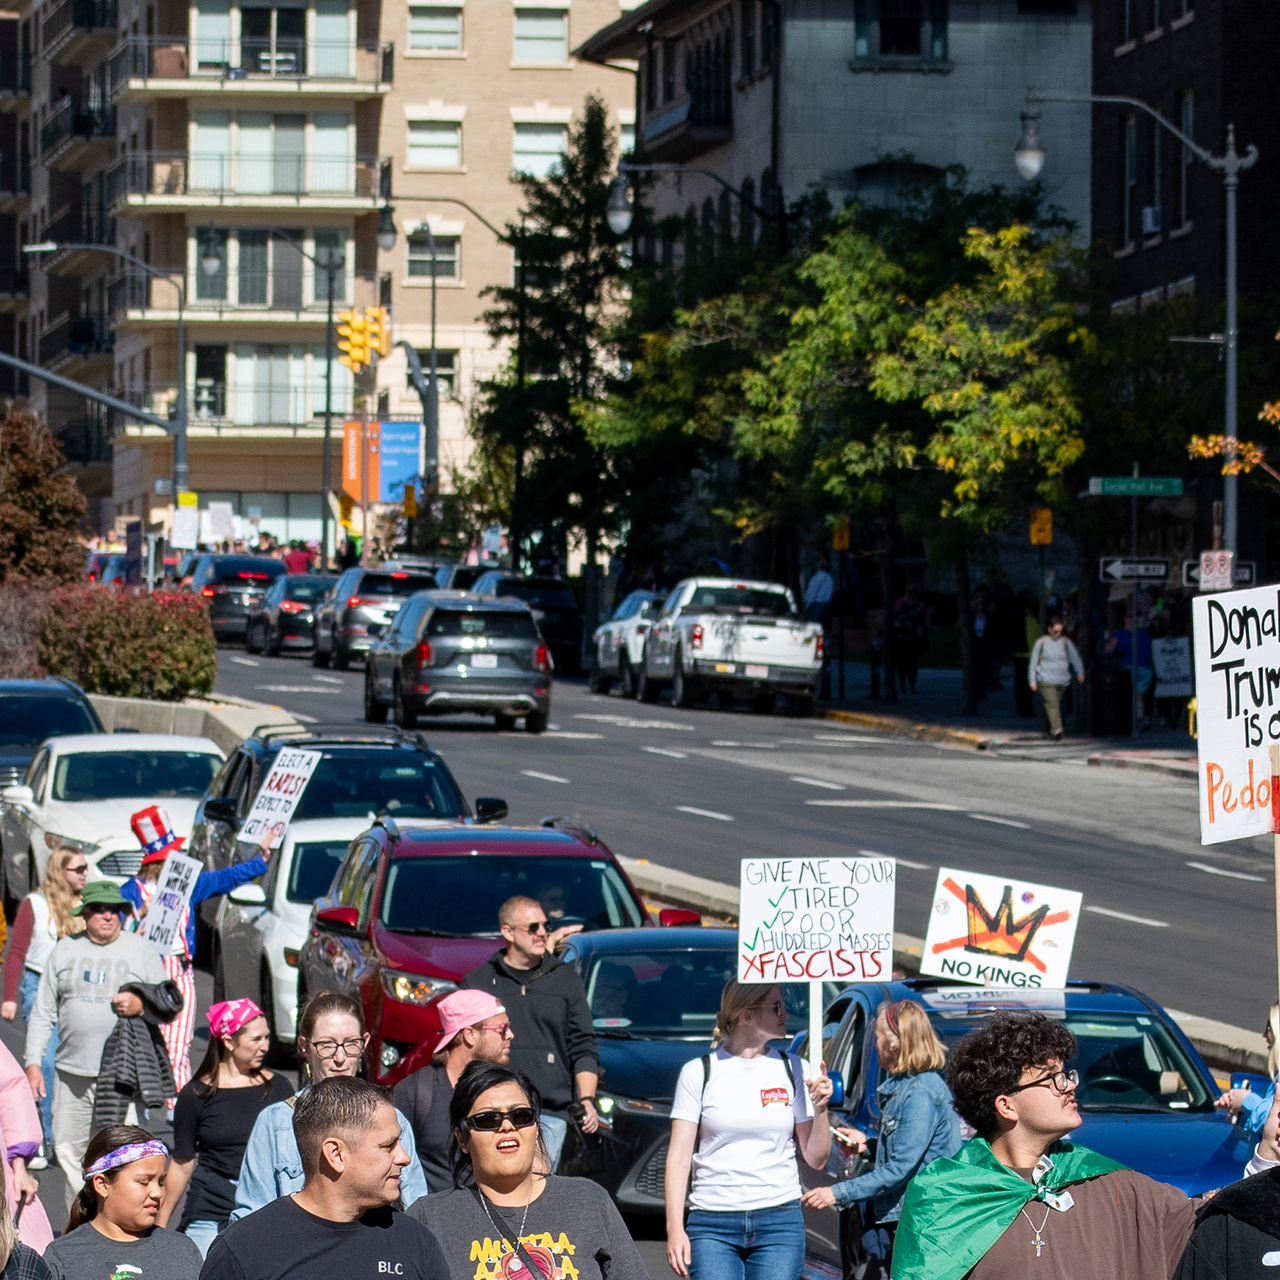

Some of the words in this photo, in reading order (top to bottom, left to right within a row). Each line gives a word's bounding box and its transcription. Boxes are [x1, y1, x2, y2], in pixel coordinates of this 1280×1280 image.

[1104, 481, 1127, 491] Social
[1150, 481, 1164, 491] Ave
[1144, 564, 1164, 576] WAY
[1244, 709, 1263, 748] is
[277, 753, 305, 768] ELECT
[302, 756, 314, 770] A
[266, 771, 308, 797] RAPIST
[256, 795, 282, 812] EXPECT
[281, 800, 292, 813] TO
[245, 819, 265, 836] GET
[746, 860, 792, 885] GIVE
[798, 860, 831, 884] ME
[842, 860, 894, 885] YOUR
[156, 890, 182, 911] AMERICA
[789, 886, 859, 909] TIRED
[781, 909, 854, 933] POOR
[761, 931, 832, 951] HUDDLED
[839, 933, 891, 950] MASSES
[940, 958, 972, 978] NO
[976, 964, 1042, 989] KINGS
[378, 1260, 404, 1276] BLC
